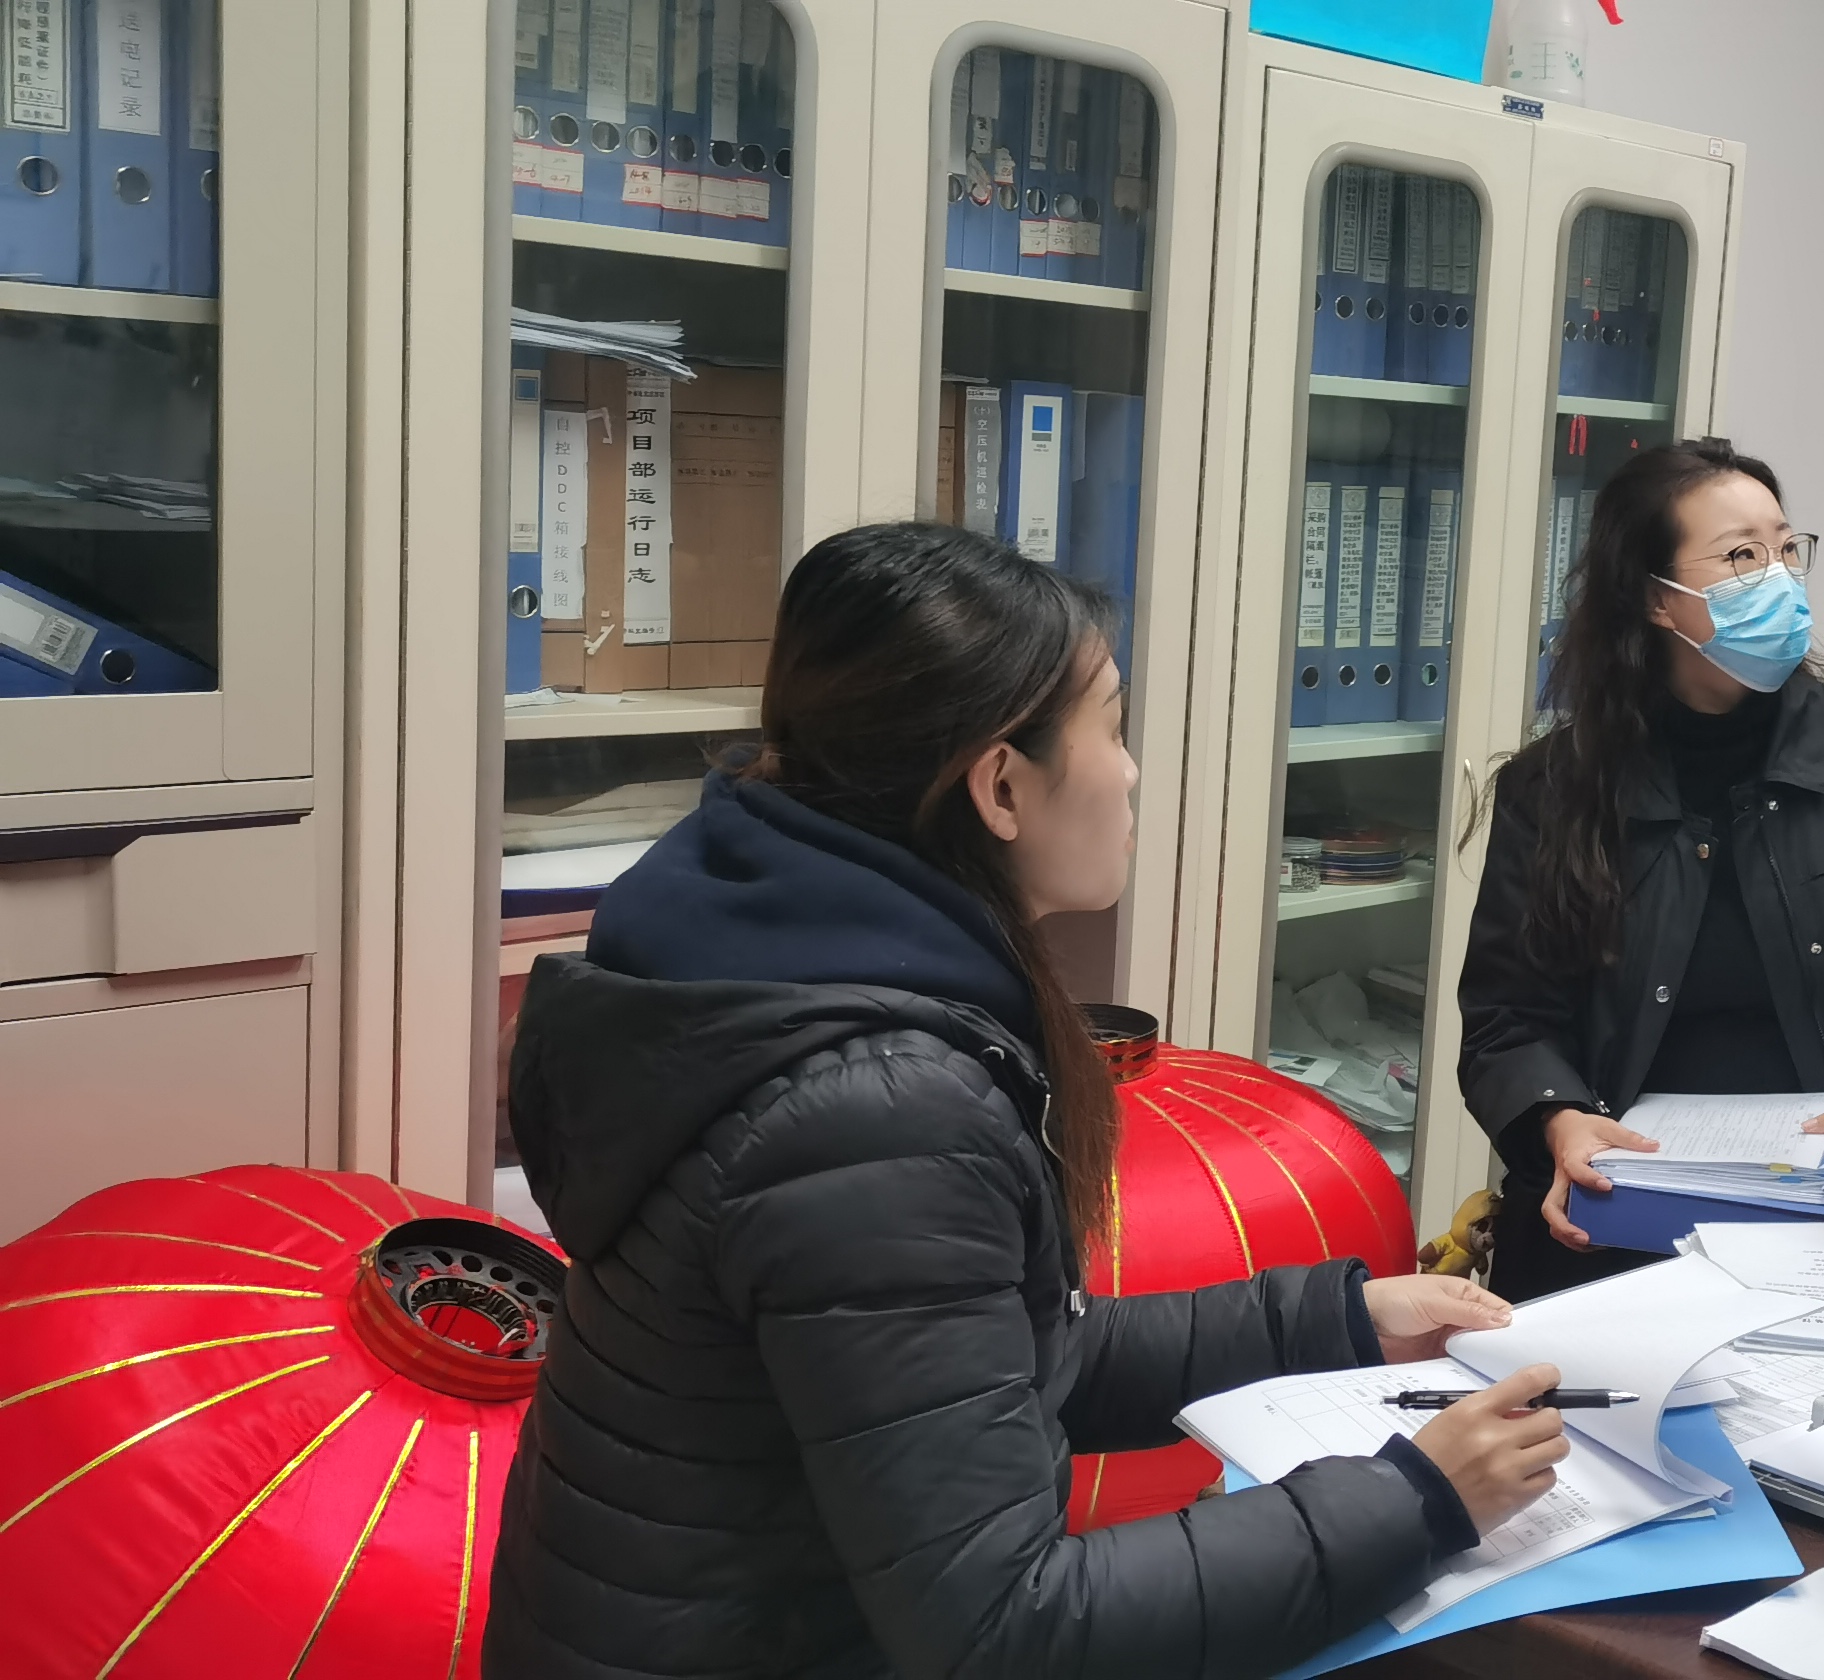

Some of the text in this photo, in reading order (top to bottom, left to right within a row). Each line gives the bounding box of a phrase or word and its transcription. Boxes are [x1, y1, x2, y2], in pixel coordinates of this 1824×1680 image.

[626, 408, 656, 584] 项目部运行日志
